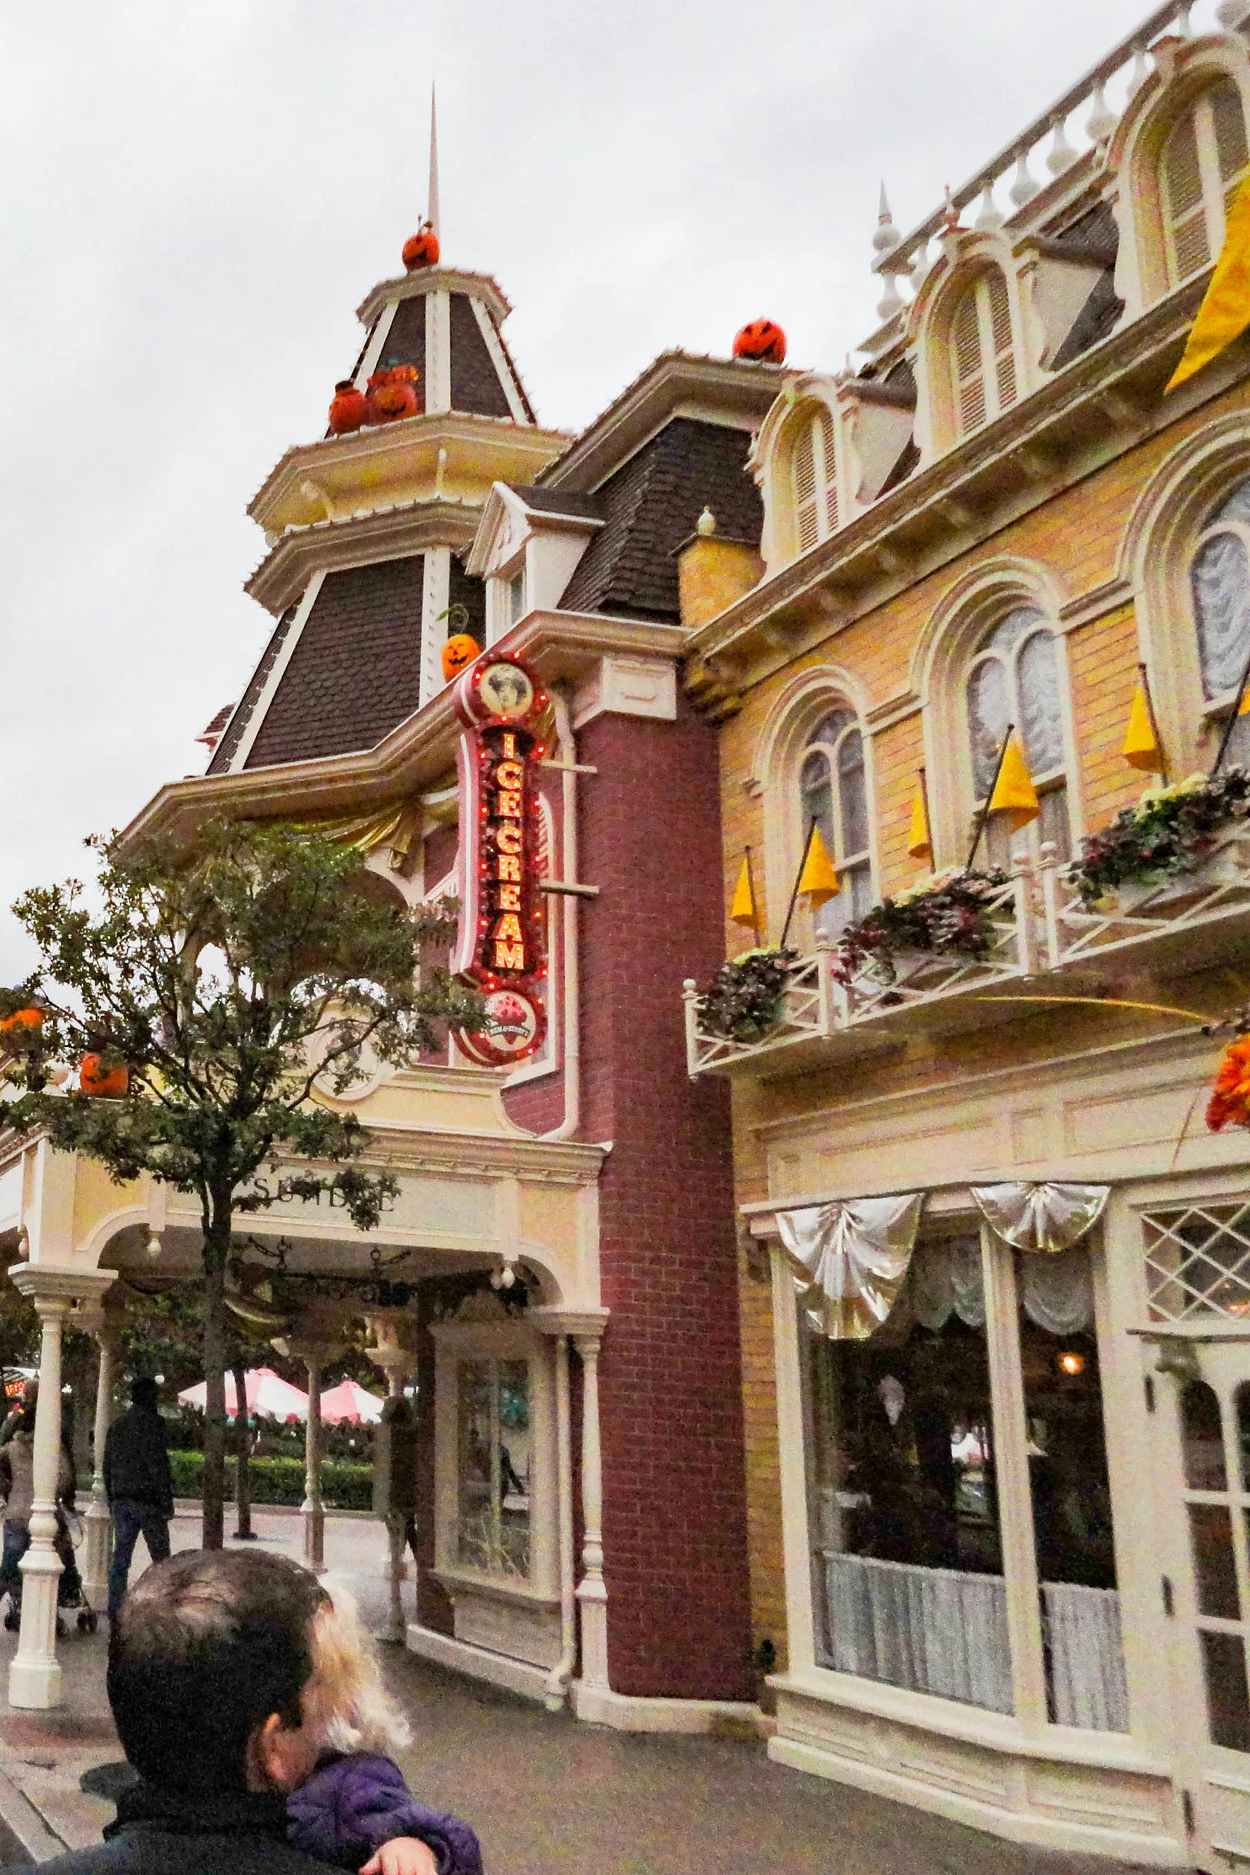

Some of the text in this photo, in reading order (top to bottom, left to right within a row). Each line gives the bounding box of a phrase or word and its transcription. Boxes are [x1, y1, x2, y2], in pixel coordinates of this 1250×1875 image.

[495, 733, 524, 970] ICE CREAM
[253, 1177, 395, 1212] SUDE
